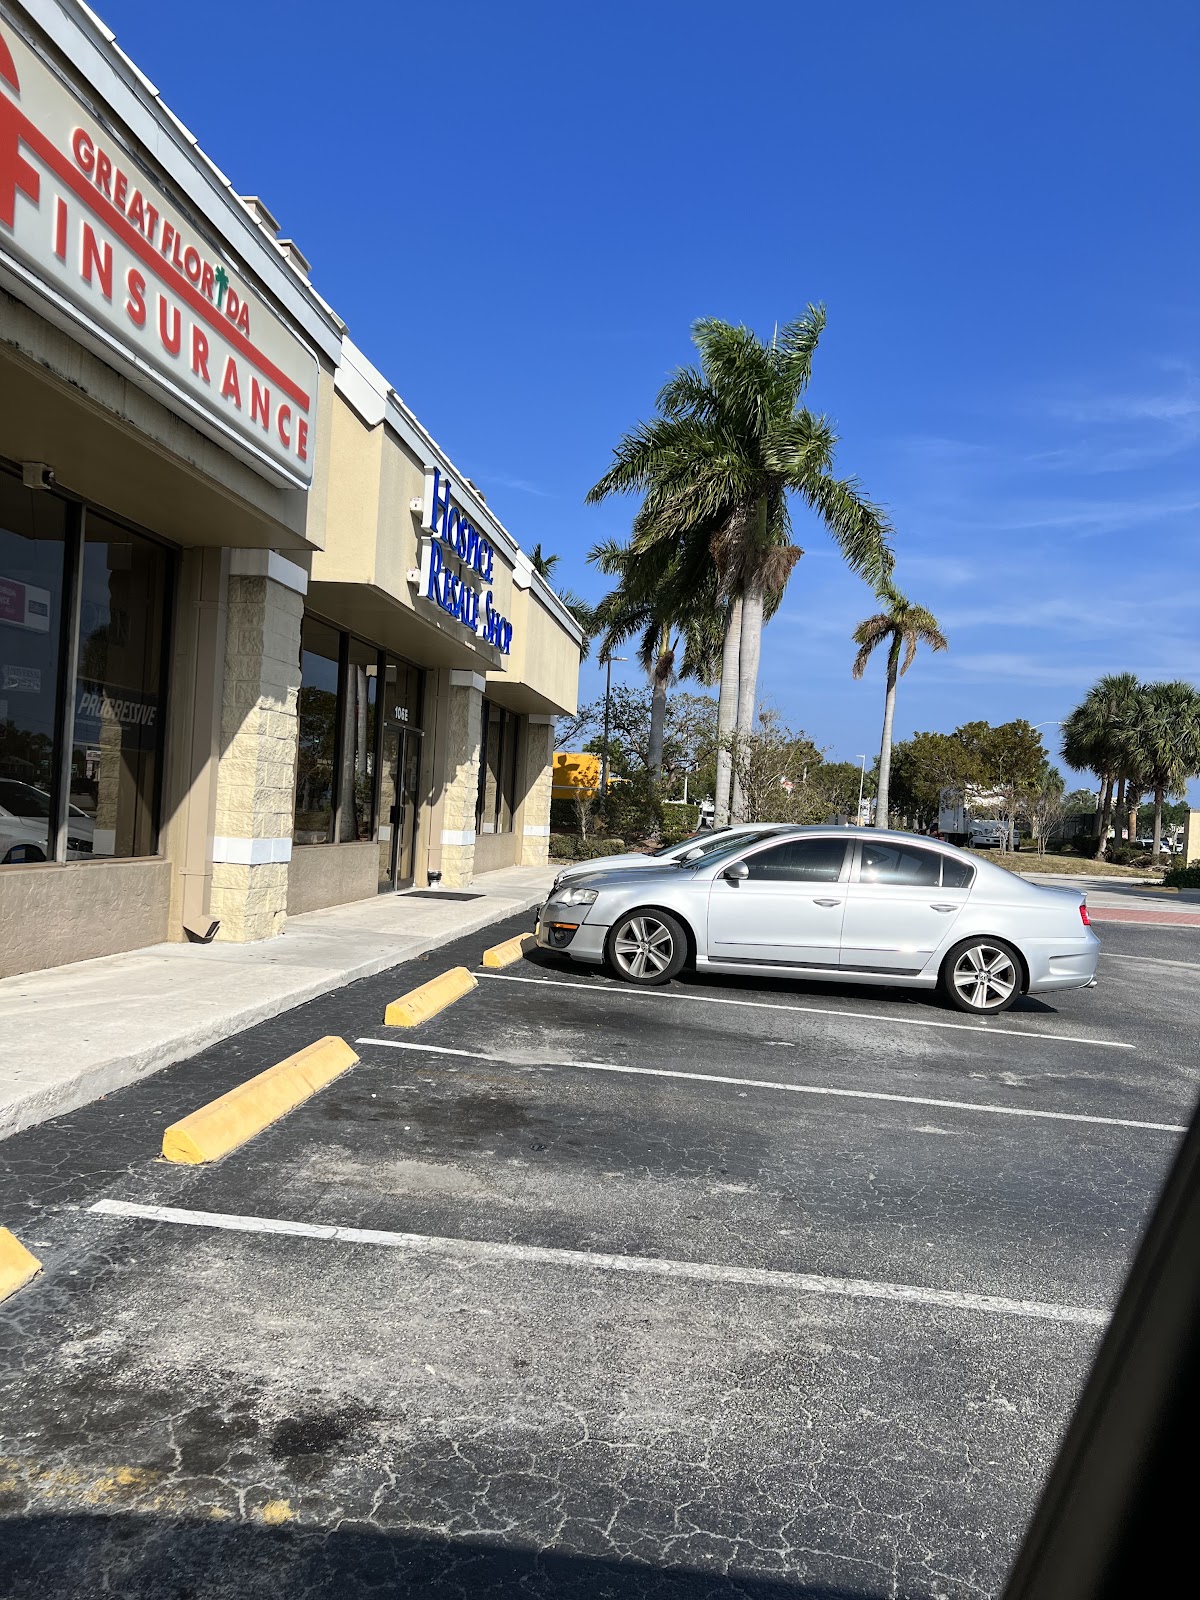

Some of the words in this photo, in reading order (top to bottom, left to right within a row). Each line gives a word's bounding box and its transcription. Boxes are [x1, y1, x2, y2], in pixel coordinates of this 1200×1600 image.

[72, 127, 160, 242] GREAT
[53, 197, 309, 461] INSURANCE
[429, 466, 494, 586] HOSPICE
[426, 537, 481, 633] RESALE
[482, 590, 513, 656] SHOP
[77, 692, 158, 727] PROGRESSIVE
